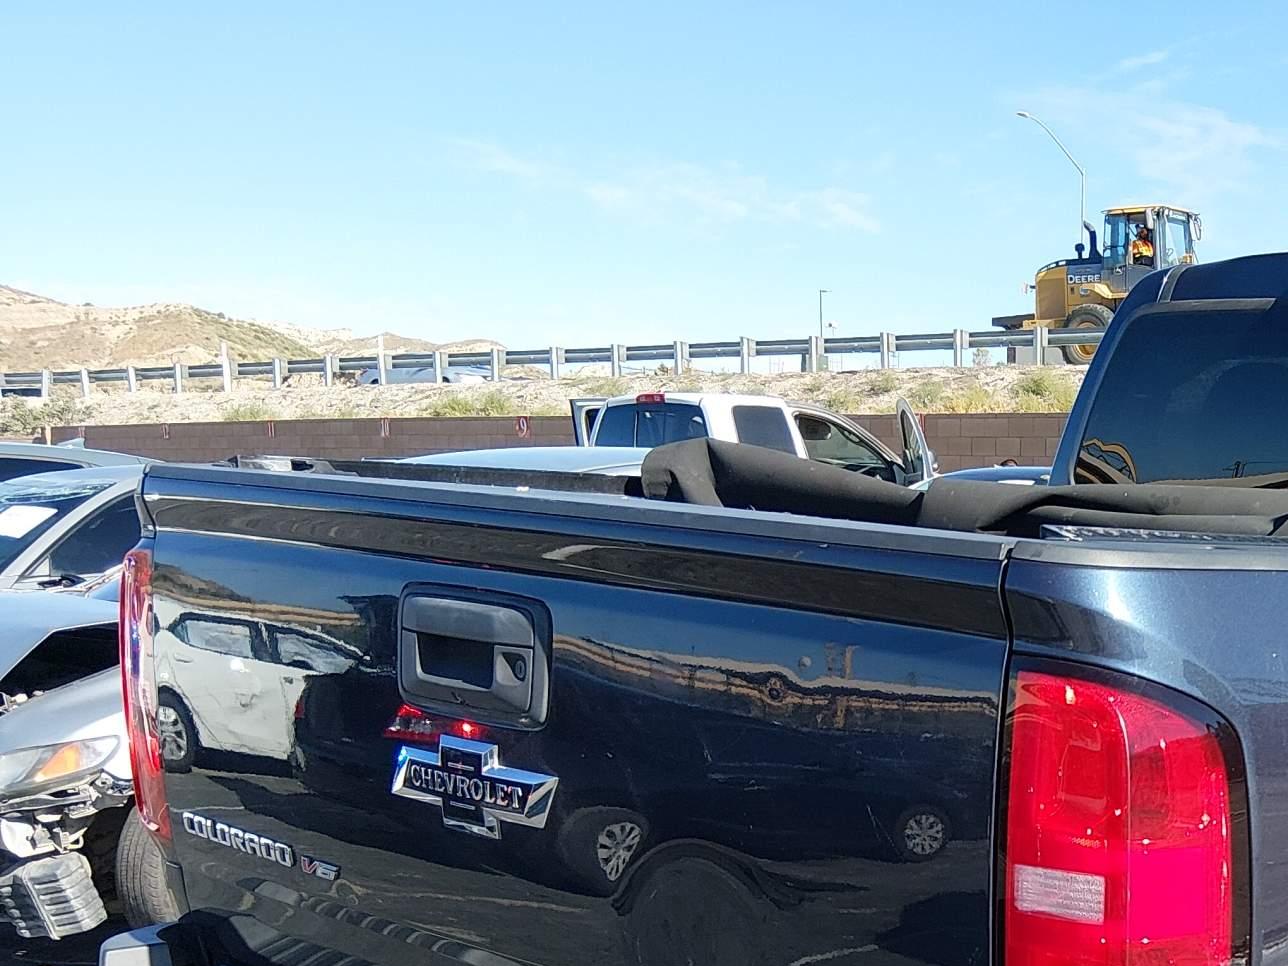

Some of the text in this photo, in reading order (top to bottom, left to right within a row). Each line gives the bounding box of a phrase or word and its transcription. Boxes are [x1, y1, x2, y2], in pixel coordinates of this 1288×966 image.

[1067, 274, 1101, 284] DEERE
[410, 764, 524, 809] CHEVROLET
[182, 811, 341, 881] COLORADO V6
